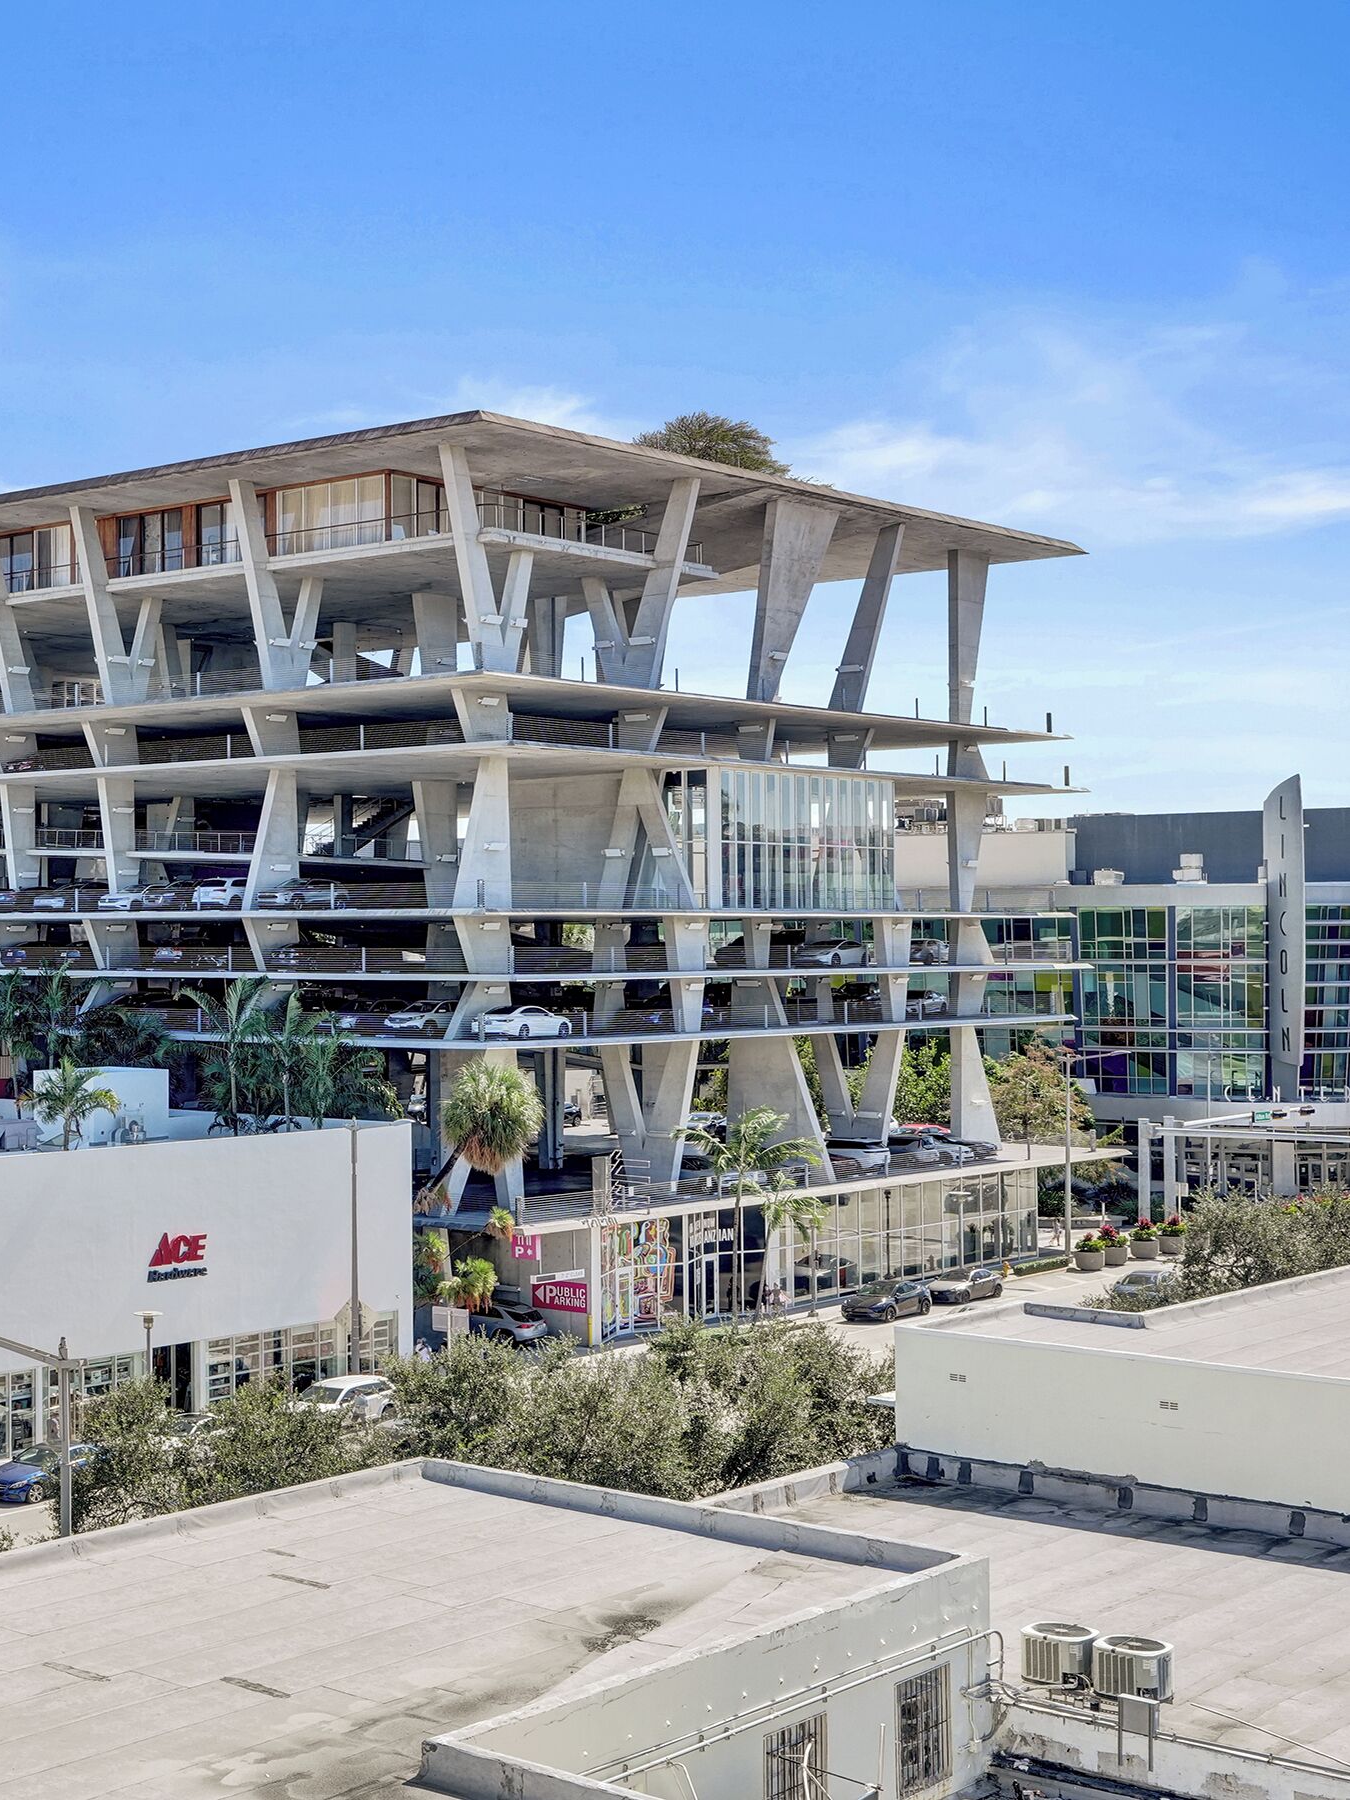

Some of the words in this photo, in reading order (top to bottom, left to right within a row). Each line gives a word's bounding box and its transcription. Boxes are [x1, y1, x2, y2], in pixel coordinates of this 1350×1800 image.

[1278, 795, 1291, 1052] LINCOLN
[148, 1232, 207, 1267] ACE
[515, 1246, 524, 1258] P
[147, 1267, 208, 1283] Hardware
[545, 1285, 586, 1304] PUBLIC
